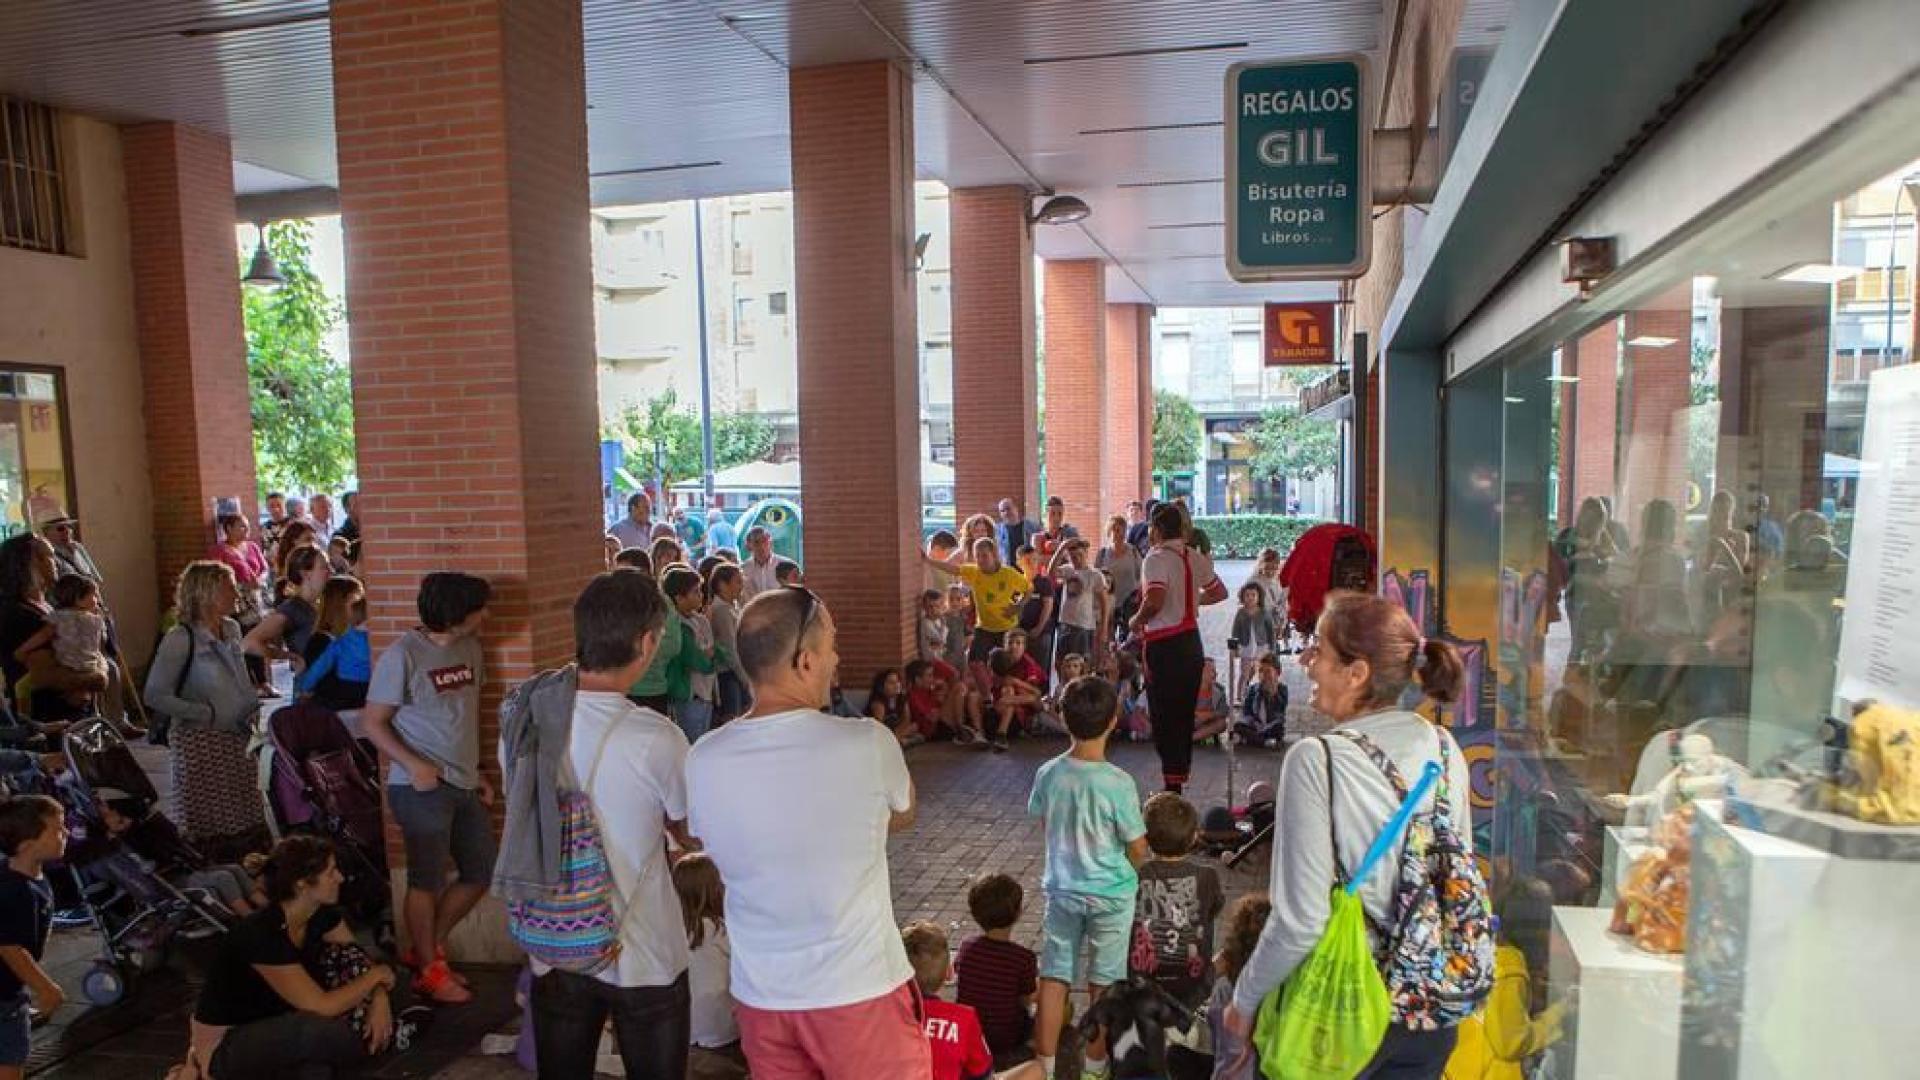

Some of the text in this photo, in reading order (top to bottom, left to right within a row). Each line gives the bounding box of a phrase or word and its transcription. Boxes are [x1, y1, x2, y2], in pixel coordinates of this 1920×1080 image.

[1242, 87, 1353, 117] REGALOS
[1257, 128, 1339, 165] GIL
[1248, 180, 1347, 201] Bisutería
[1269, 206, 1325, 227] Ropa
